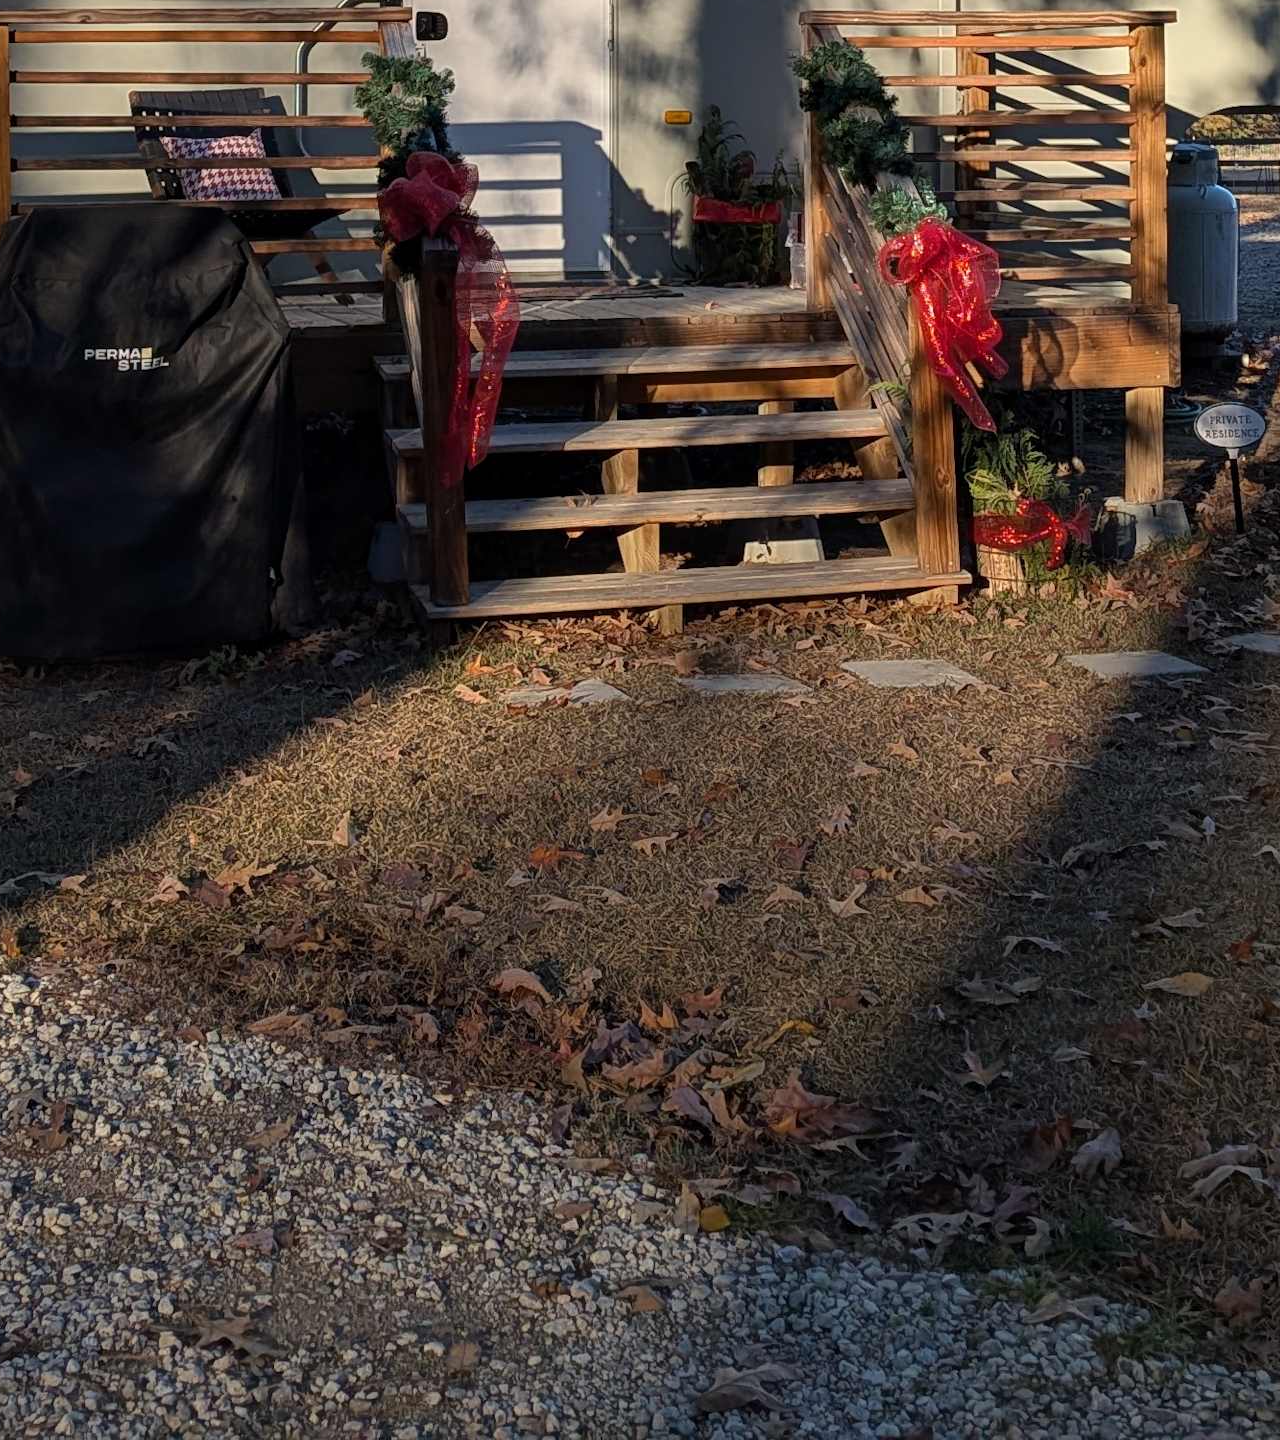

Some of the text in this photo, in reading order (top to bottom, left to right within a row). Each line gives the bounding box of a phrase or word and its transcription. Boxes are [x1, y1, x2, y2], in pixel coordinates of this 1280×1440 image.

[84, 348, 140, 360] PERMA
[118, 357, 170, 371] STEEL
[1209, 415, 1253, 425] PRIVATE
[1205, 429, 1261, 439] RESIDENCE
